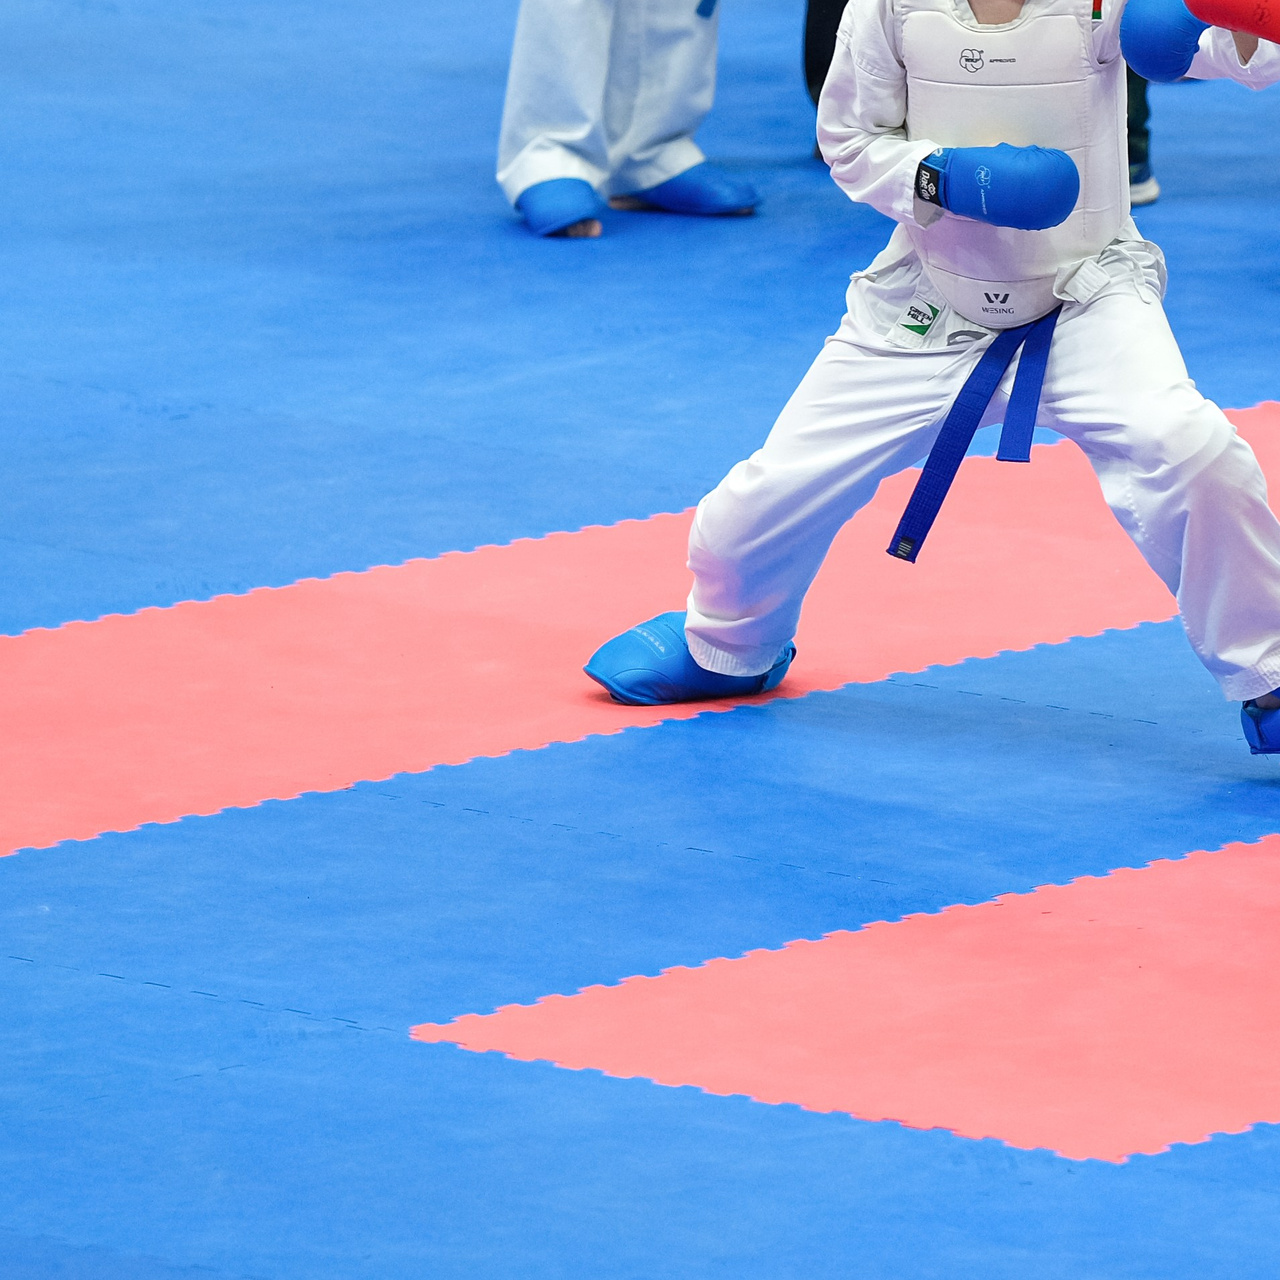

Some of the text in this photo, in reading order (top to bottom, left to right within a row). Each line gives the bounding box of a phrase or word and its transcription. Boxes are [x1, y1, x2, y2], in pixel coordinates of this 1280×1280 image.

[907, 310, 925, 325] HILL
[909, 305, 933, 322] GREEN
[981, 306, 1015, 315] WESING
